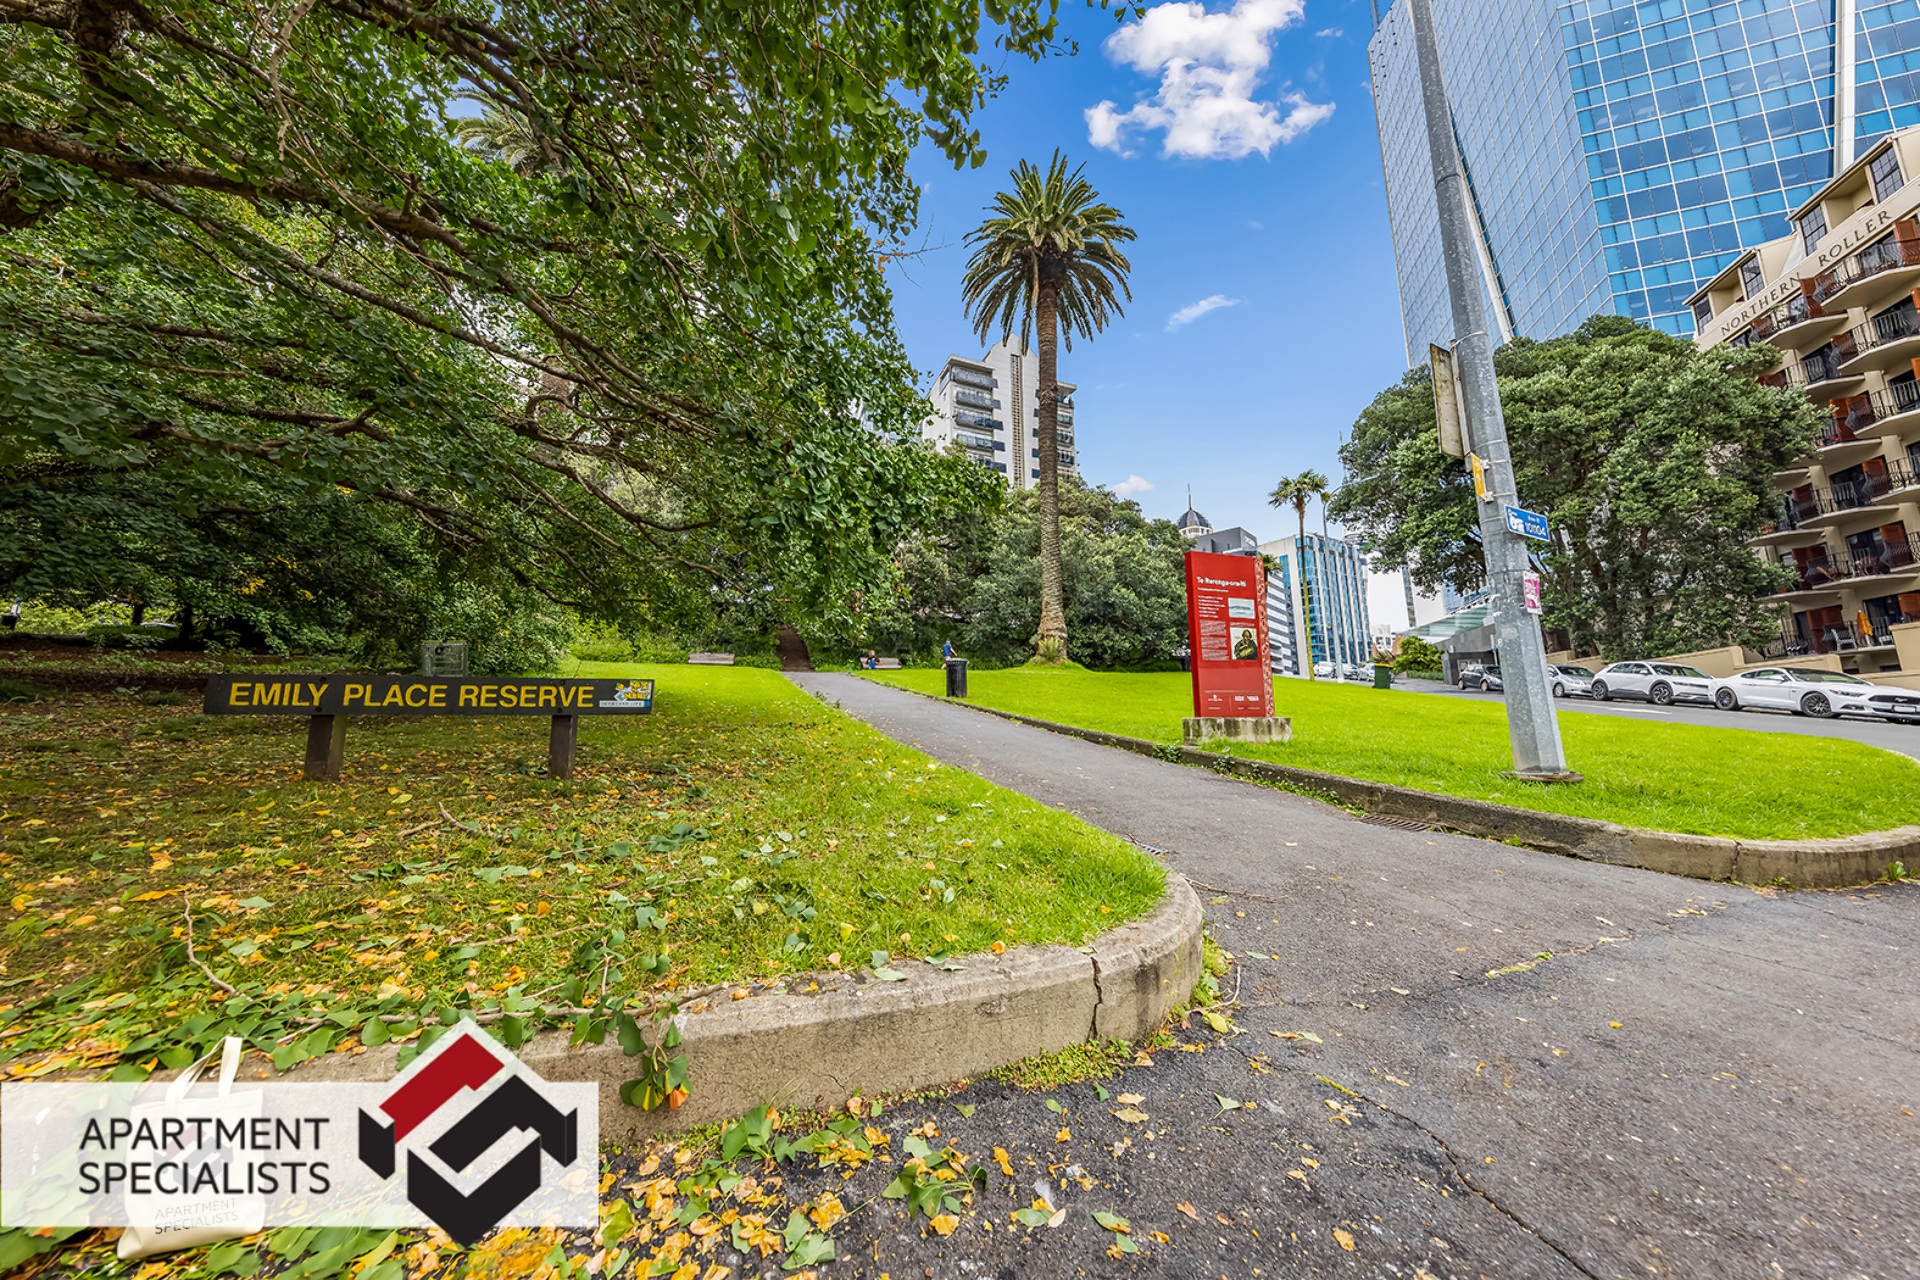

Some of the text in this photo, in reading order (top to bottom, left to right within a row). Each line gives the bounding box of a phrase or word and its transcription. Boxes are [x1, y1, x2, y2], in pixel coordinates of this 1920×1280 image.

[1720, 210, 1892, 336] NORTHERN ROLLER
[229, 682, 329, 707] EMILY
[343, 683, 448, 708] PLACE
[458, 684, 595, 708] RESERVE
[155, 1198, 237, 1220] APARTMENT
[155, 1210, 239, 1235] SPECIALISTS
